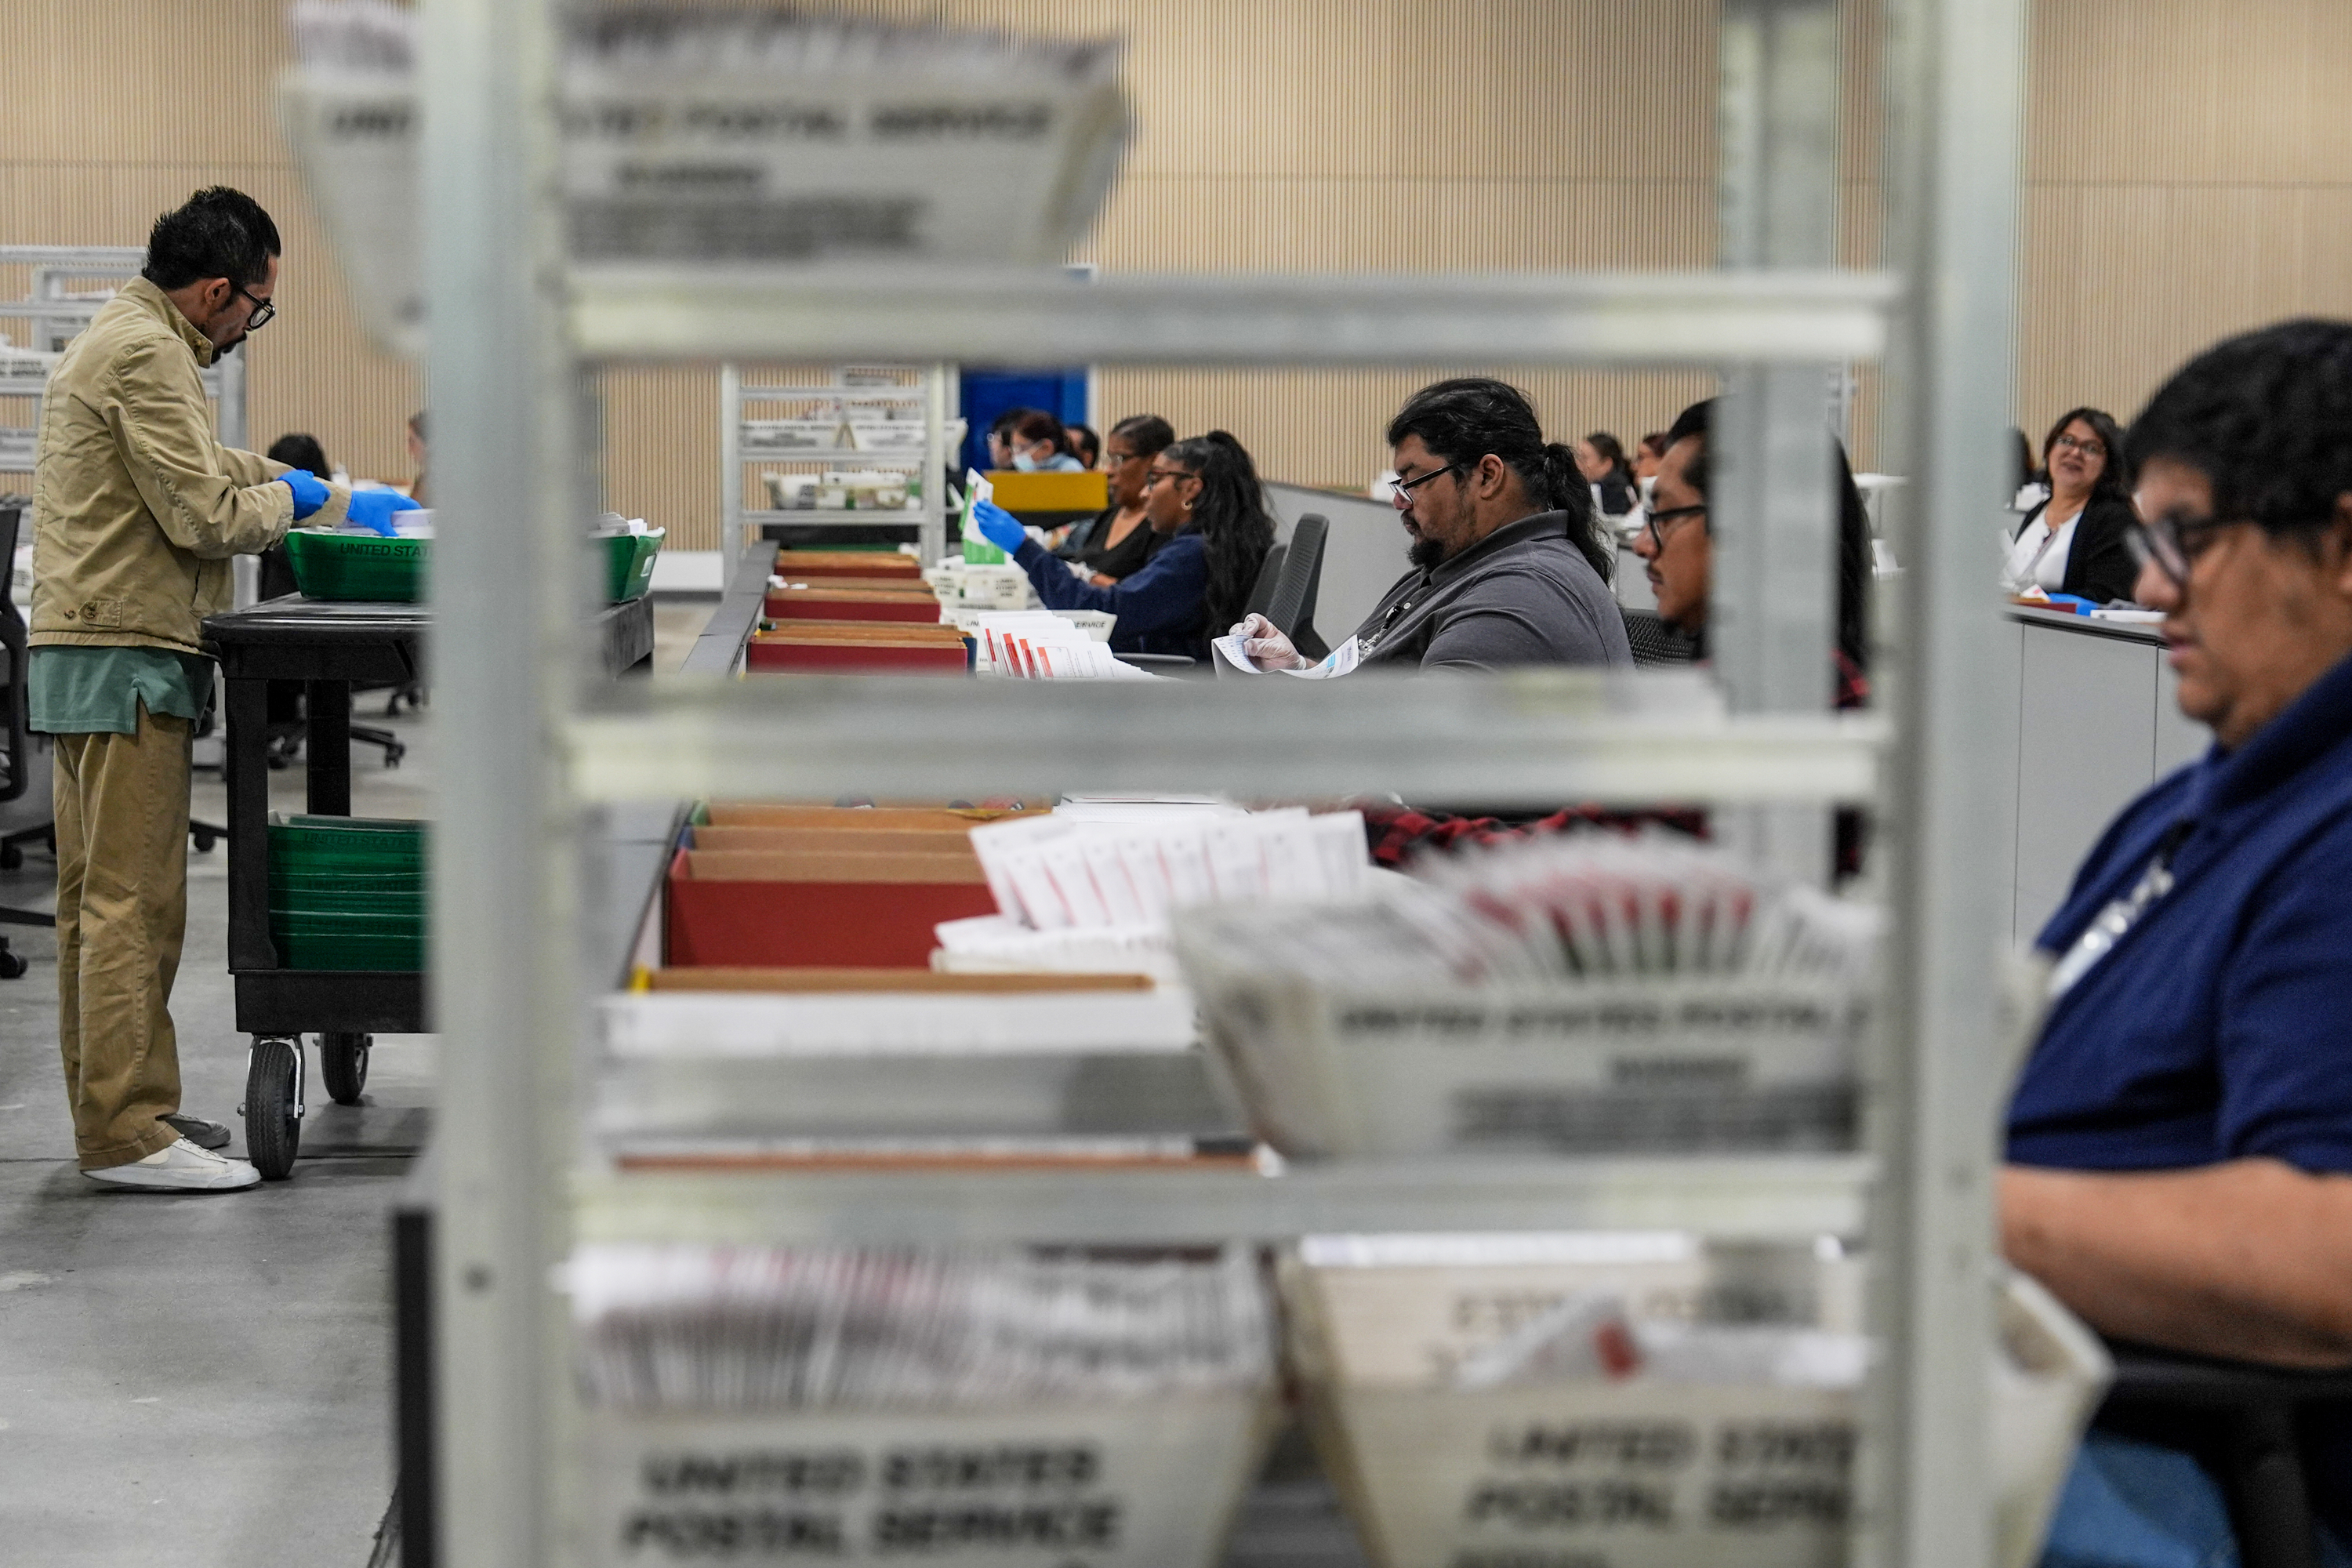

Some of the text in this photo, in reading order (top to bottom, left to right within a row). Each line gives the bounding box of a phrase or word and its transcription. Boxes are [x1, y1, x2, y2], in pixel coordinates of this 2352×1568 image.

[340, 543, 429, 557] UNITED STAT
[642, 1443, 1099, 1497] UNITED STATES
[622, 1498, 1126, 1556] POSTAL SERVICE
